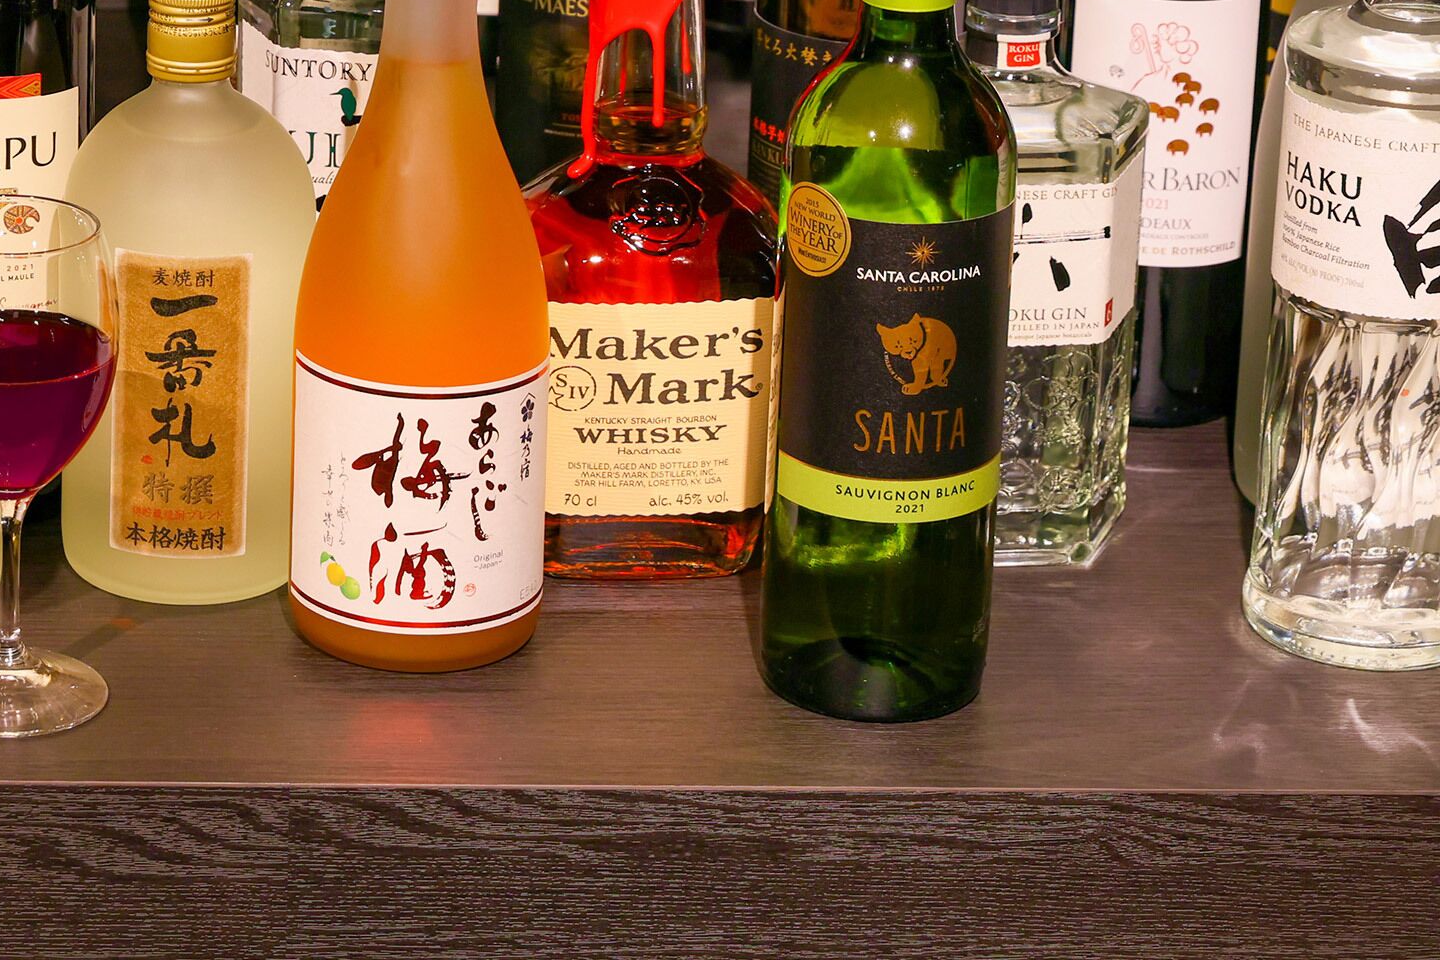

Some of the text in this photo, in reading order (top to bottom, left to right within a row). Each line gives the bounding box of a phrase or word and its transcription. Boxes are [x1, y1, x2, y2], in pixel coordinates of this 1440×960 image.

[1007, 43, 1041, 54] ROKU
[1013, 52, 1035, 64] GIN
[265, 49, 373, 82] SUNTORY
[1293, 113, 1440, 154] THE JAPANESE CRAFT
[1162, 166, 1241, 192] BARON
[1287, 150, 1363, 200] HAKU
[1054, 189, 1098, 200] CRAFT
[1285, 181, 1363, 228] VODKA
[790, 207, 844, 240] WINERY OF
[808, 208, 836, 222] WORLD
[789, 224, 839, 254] THE YEAR
[1295, 229, 1341, 253] Japanese Rice
[6, 263, 35, 272] 2021
[1300, 243, 1331, 263] Charcoal
[1330, 253, 1372, 271] Filtration
[8, 273, 35, 282] MAULE
[152, 267, 216, 288] 麦焼酎
[856, 264, 982, 285] SANTA CAROLINA
[1051, 307, 1087, 320] GIN
[1012, 322, 1100, 332] TILLED IN JAPAN
[550, 326, 764, 361] Maker's
[603, 369, 760, 405] Mark
[584, 414, 718, 426] KENTUCKY STRAIGHT BOURBON
[573, 424, 728, 445] WHISKY
[853, 407, 966, 456] SANTA
[617, 447, 682, 456] Handmade
[568, 458, 729, 471] DISTILLED, AGED AND BOTTLED BY THE
[580, 467, 717, 479] MAKER'S MARK DISTILLERY, INC.
[574, 478, 597, 487] STAR
[598, 479, 618, 488] HILL
[619, 479, 647, 489] FARM,
[648, 478, 690, 489] LORETTO,
[704, 476, 723, 485] USA
[835, 480, 976, 501] SAUVIGNON BLANC
[563, 490, 729, 507] 70 cl alc. 45% vol.
[895, 503, 925, 514] 2021
[125, 521, 227, 551] 本格焼酎
[473, 549, 504, 563] Original
